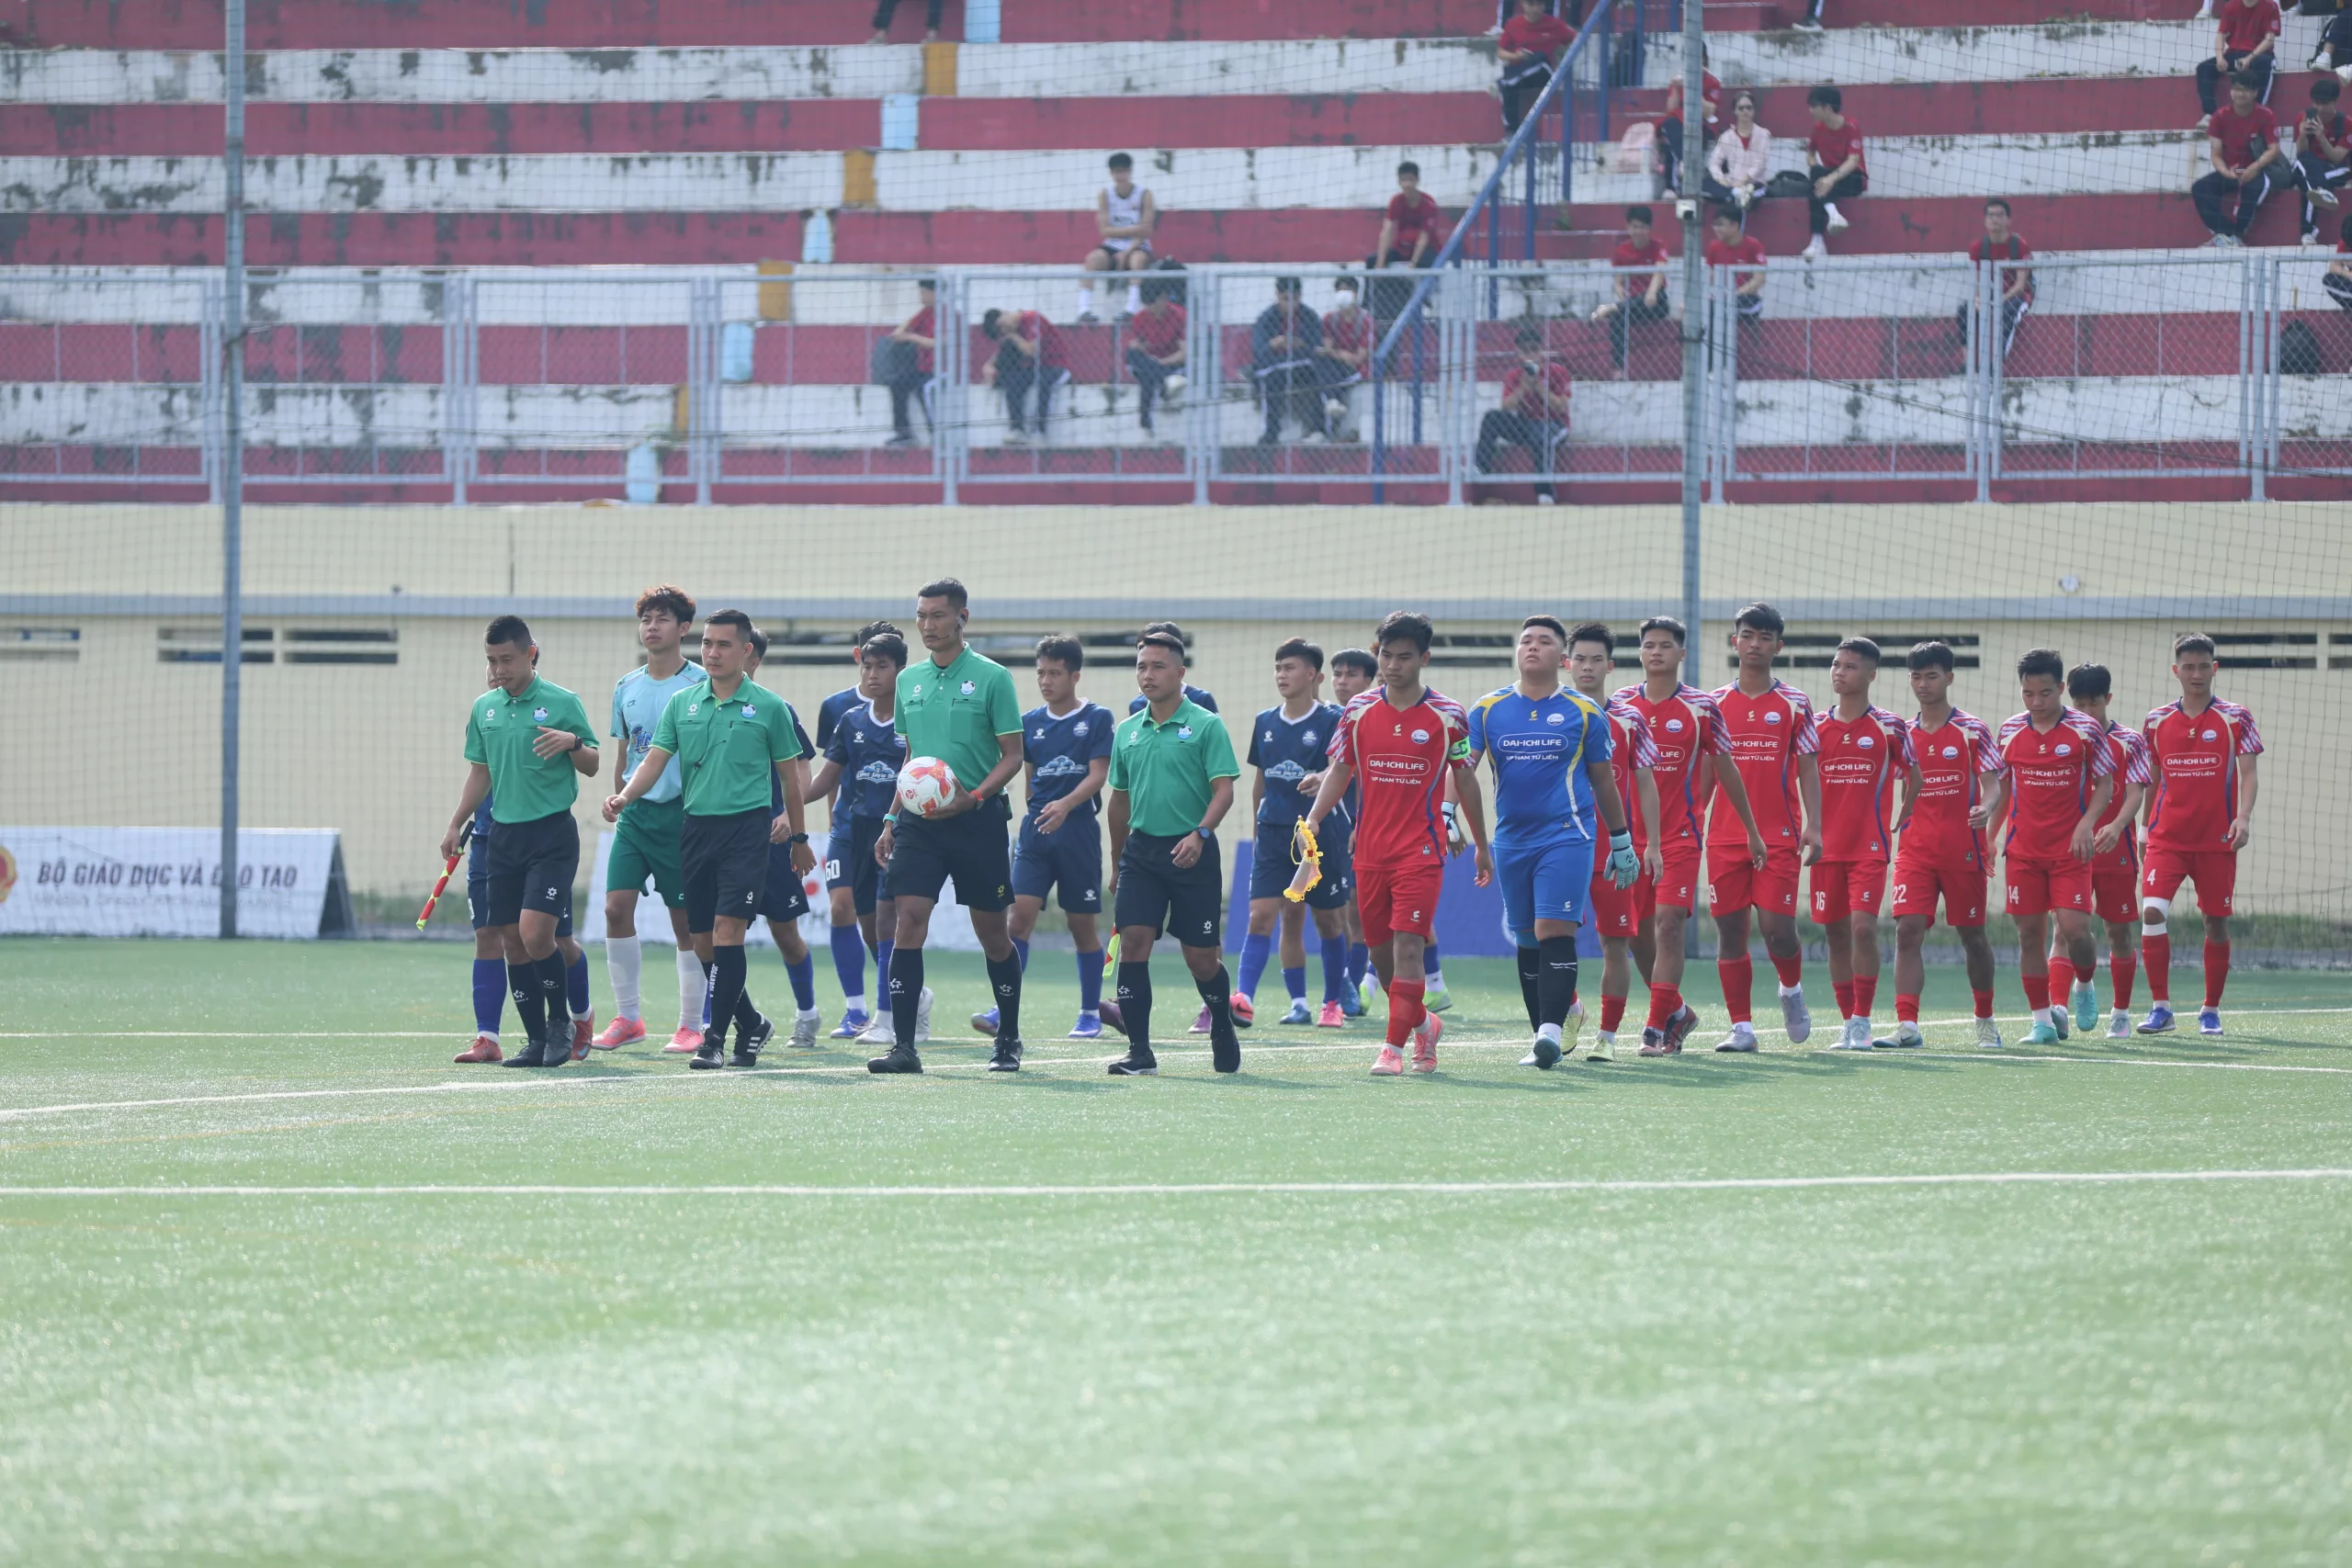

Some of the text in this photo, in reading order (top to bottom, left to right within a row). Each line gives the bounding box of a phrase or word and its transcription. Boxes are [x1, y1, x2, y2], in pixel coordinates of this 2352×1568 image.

[1370, 760, 1425, 771] DAI-ICHI LIFE
[1923, 774, 1960, 784] -ICHI LIFE
[38, 857, 66, 890] BỘ
[73, 858, 122, 887] GIÁO
[129, 863, 174, 892] DỤC
[209, 863, 254, 888] ĐO
[2146, 868, 2156, 886] 4
[1709, 884, 1717, 904] 9
[1815, 891, 1826, 911] 16
[1893, 884, 1906, 905] 22
[2008, 885, 2019, 905] 14
